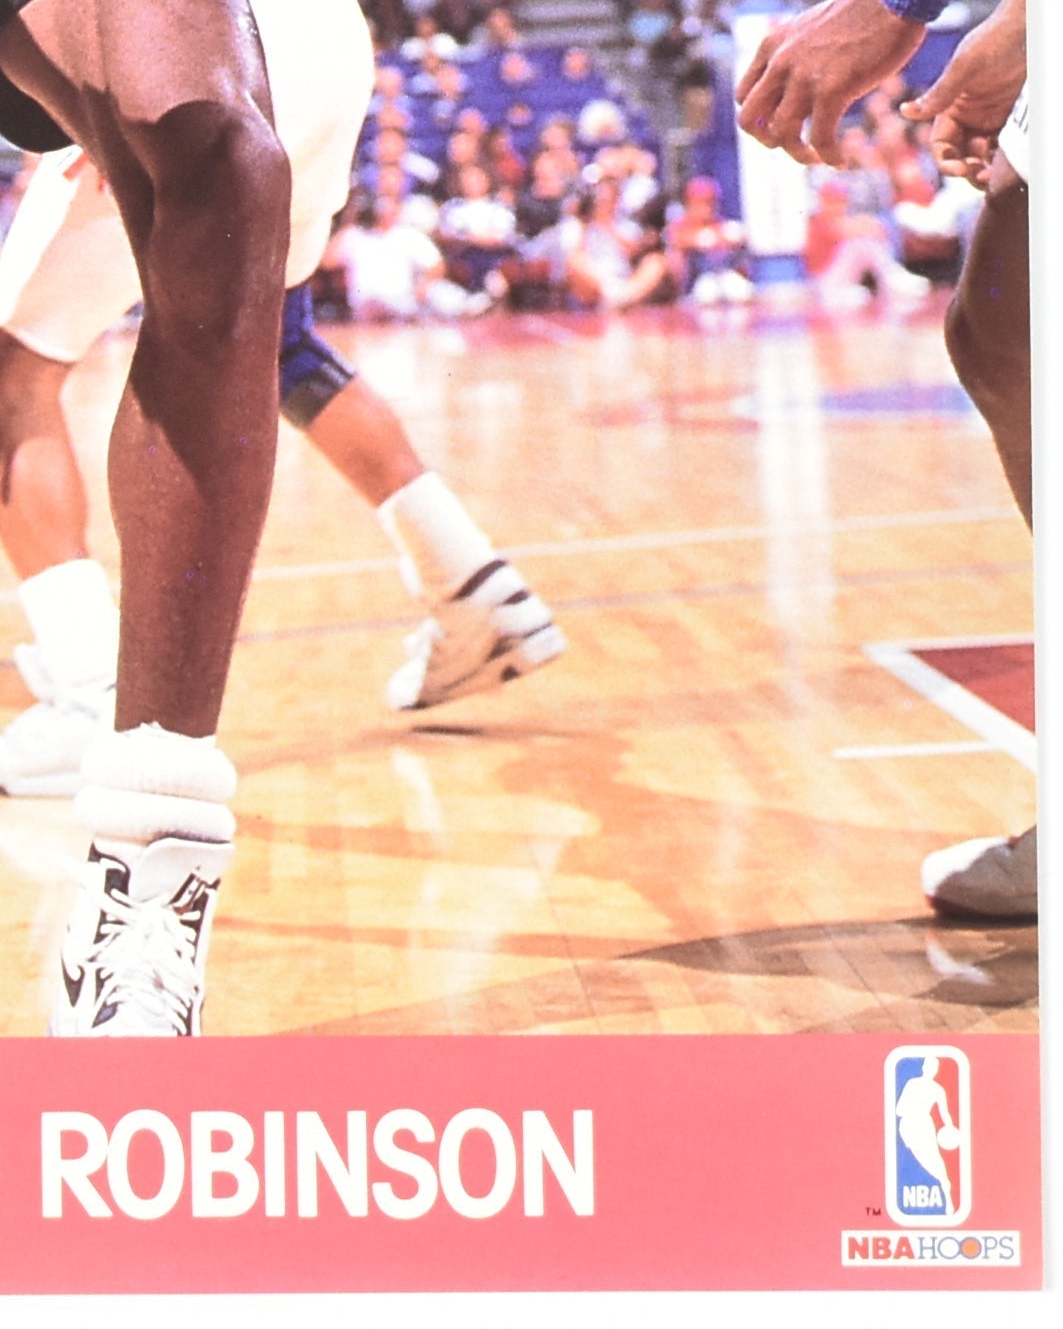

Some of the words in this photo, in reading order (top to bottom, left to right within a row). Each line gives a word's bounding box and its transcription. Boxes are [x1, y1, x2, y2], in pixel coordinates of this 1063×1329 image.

[41, 1108, 595, 1220] ROBINSON
[902, 1184, 944, 1208] NBA
[865, 1207, 882, 1217] TM
